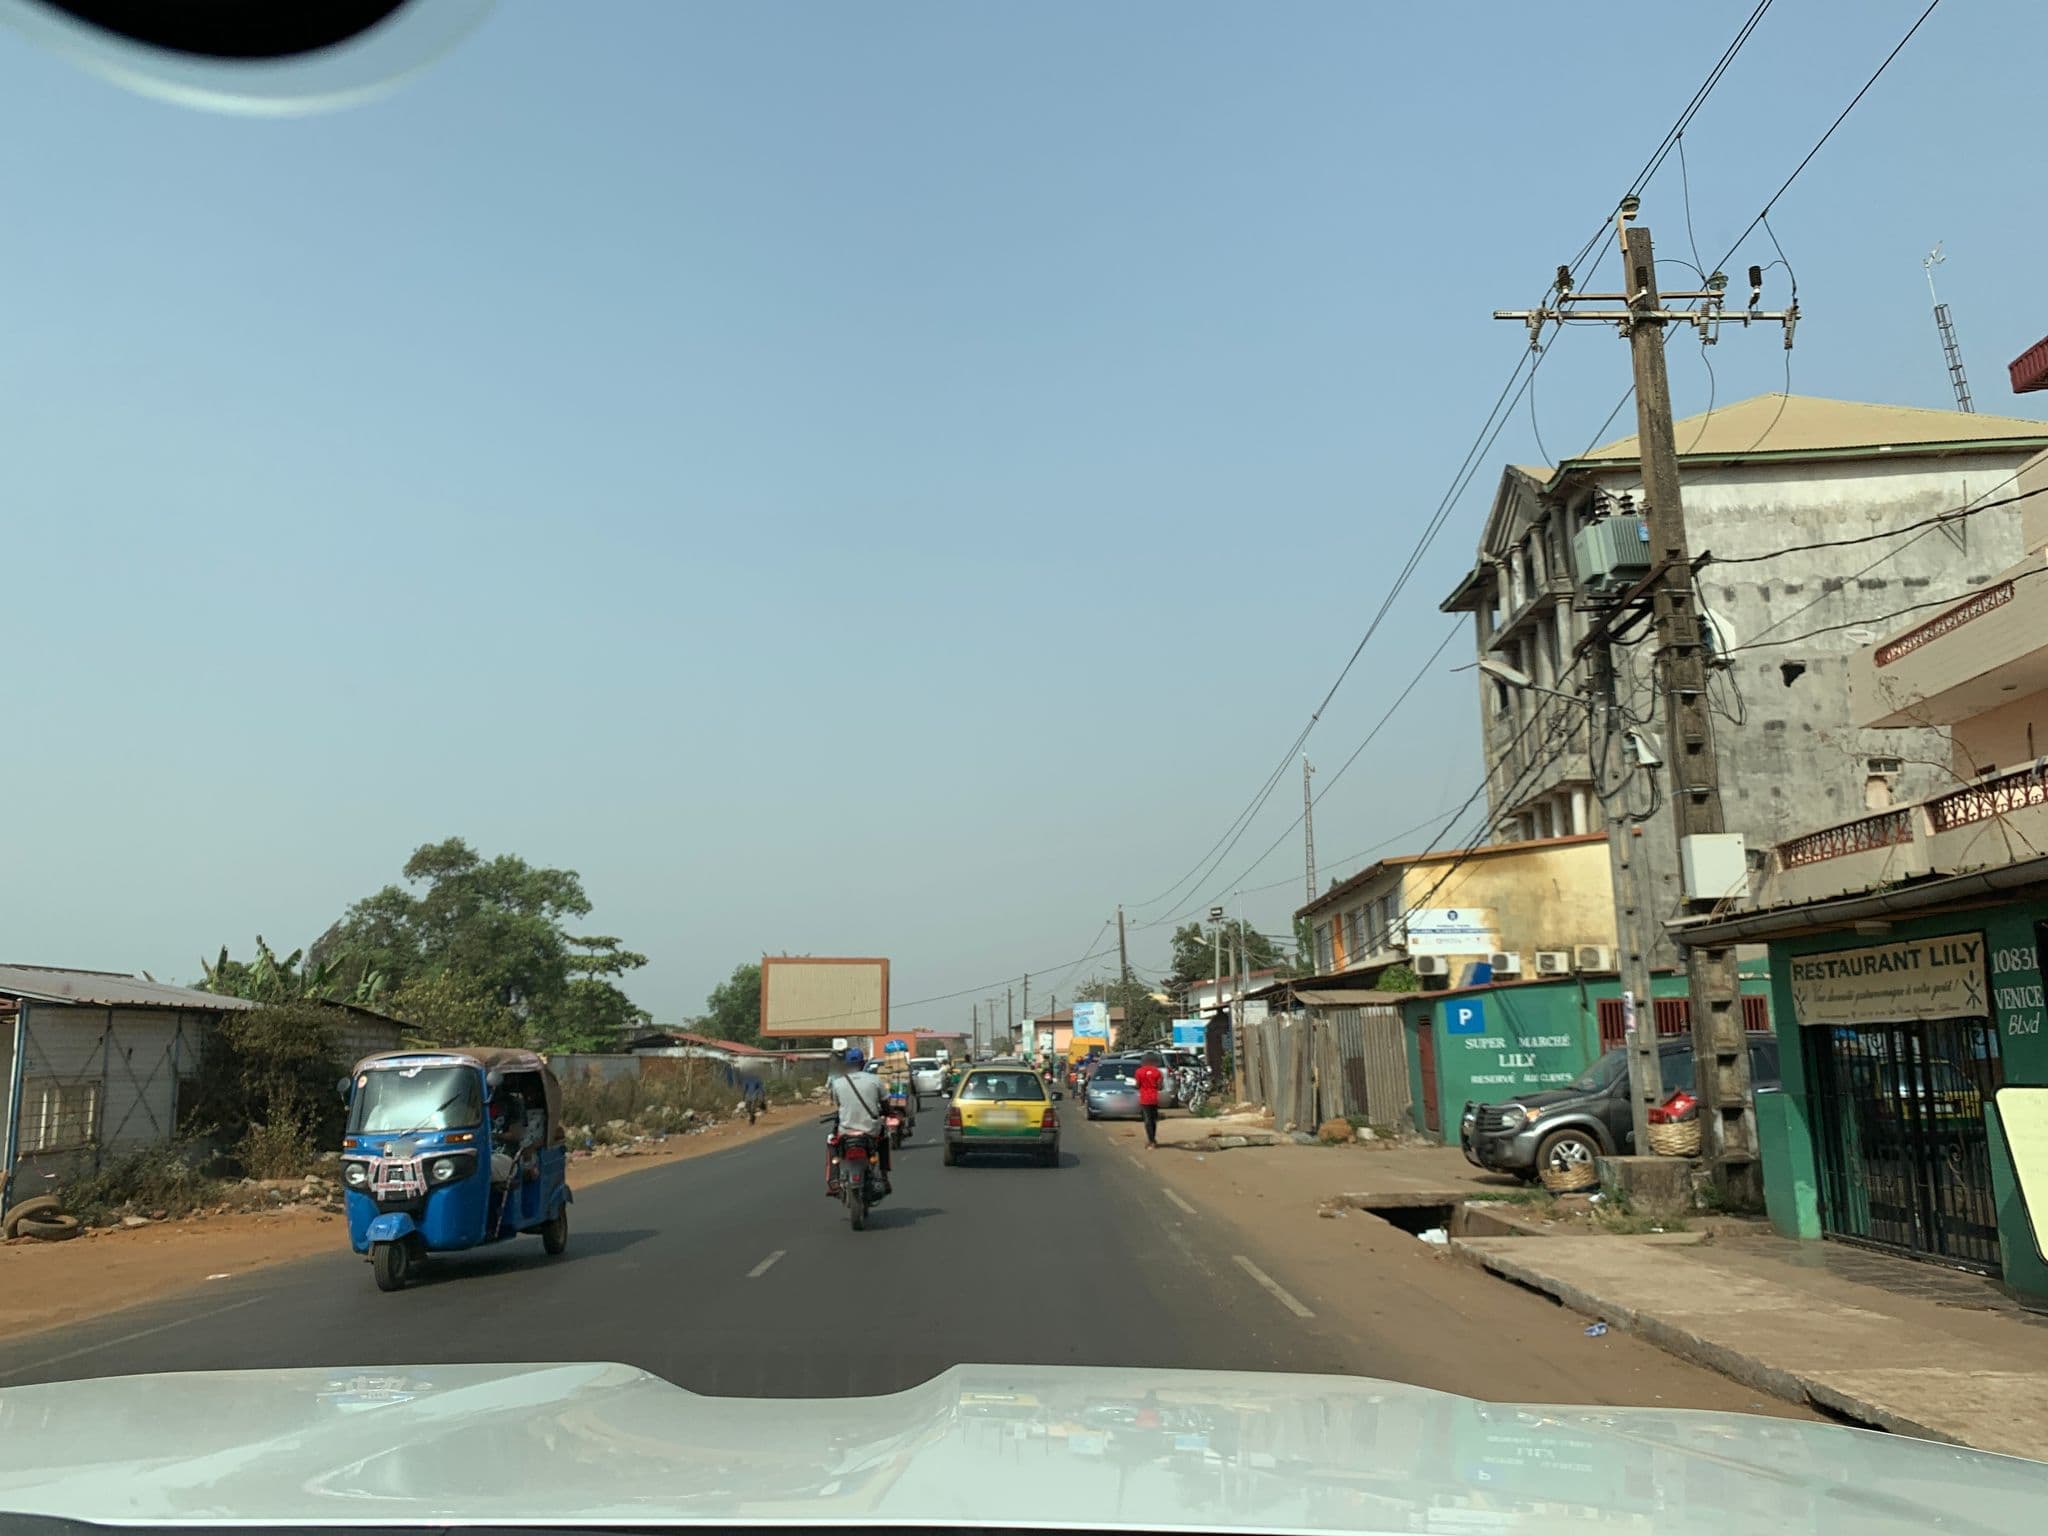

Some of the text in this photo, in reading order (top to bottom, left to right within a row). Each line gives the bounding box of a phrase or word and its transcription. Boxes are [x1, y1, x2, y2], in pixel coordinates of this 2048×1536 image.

[1792, 940, 1981, 982] RESTAURANT LILY
[1992, 946, 2040, 974] 10831
[1993, 986, 2045, 1010] VENICE
[1458, 1008, 1473, 1026] P
[1464, 1037, 1506, 1050] SUPER
[1498, 1053, 1536, 1068] LILY
